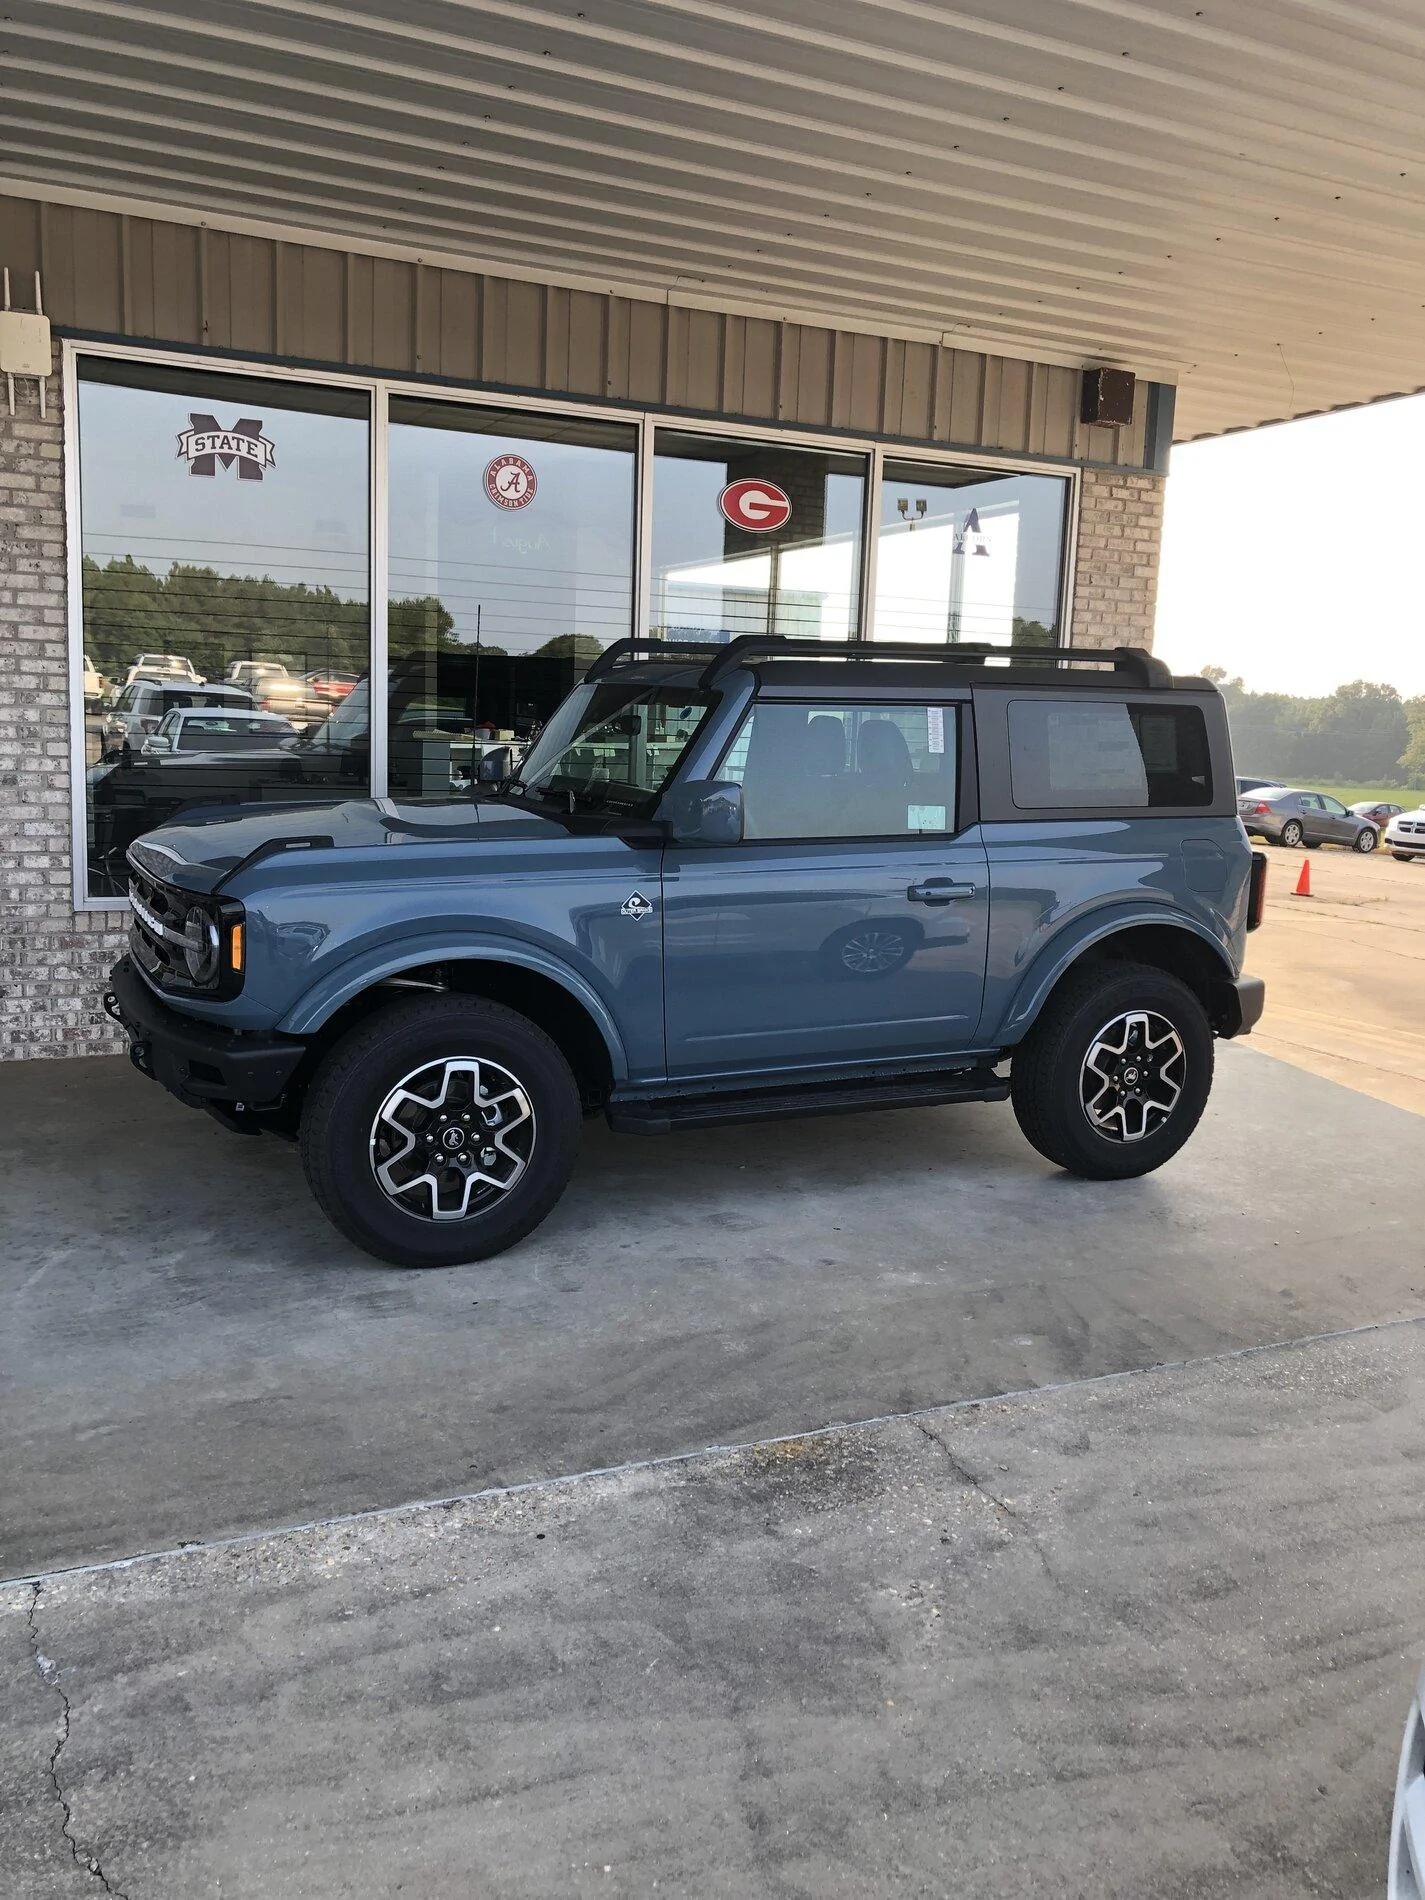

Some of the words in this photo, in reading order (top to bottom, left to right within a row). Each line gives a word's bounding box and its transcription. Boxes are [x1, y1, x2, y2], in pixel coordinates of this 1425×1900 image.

[194, 435, 259, 458] STATE
[490, 458, 534, 480] ALABAMA
[501, 471, 521, 492] A
[489, 484, 519, 506] CRIMSON
[519, 487, 535, 504] TIDE
[722, 481, 790, 530] G
